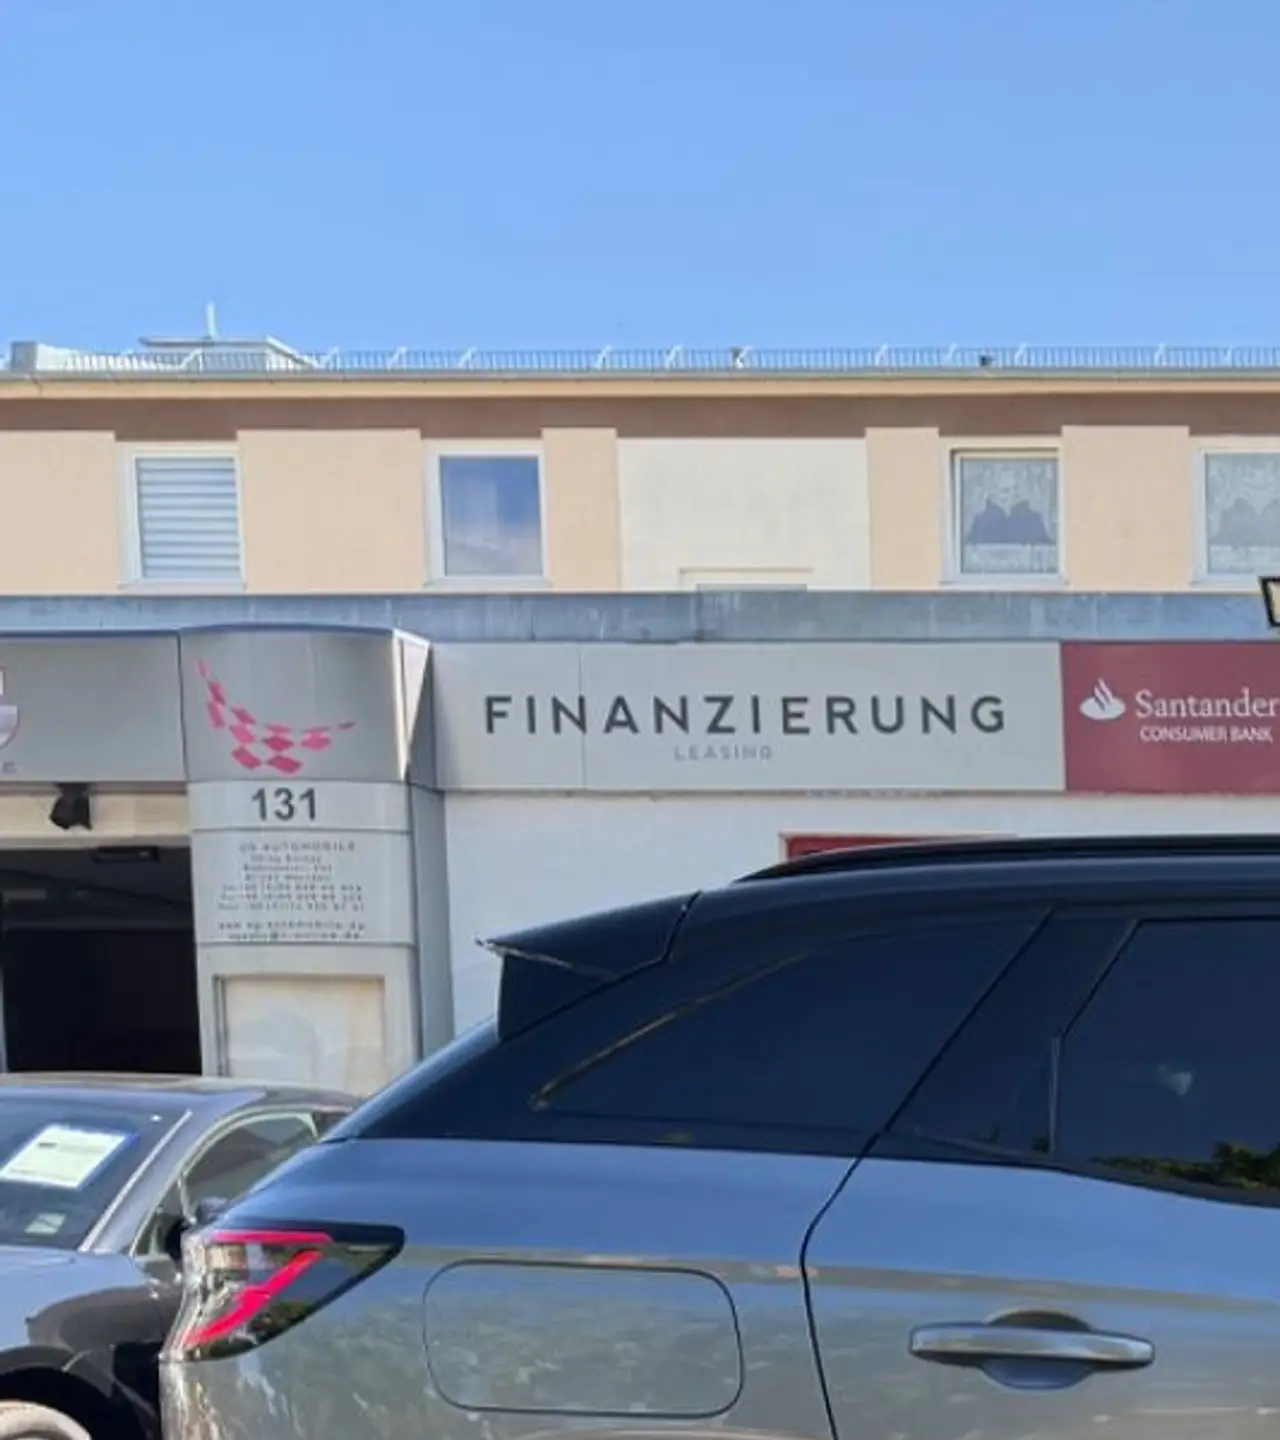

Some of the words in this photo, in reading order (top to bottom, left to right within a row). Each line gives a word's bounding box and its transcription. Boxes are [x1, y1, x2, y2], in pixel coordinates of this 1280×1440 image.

[484, 695, 1006, 735] FINANZIERUNG
[1134, 688, 1280, 719] Santander
[1140, 725, 1229, 743] CONSUMER
[1230, 725, 1274, 743] BANK
[673, 744, 774, 762] LEASING
[251, 787, 317, 822] 131
